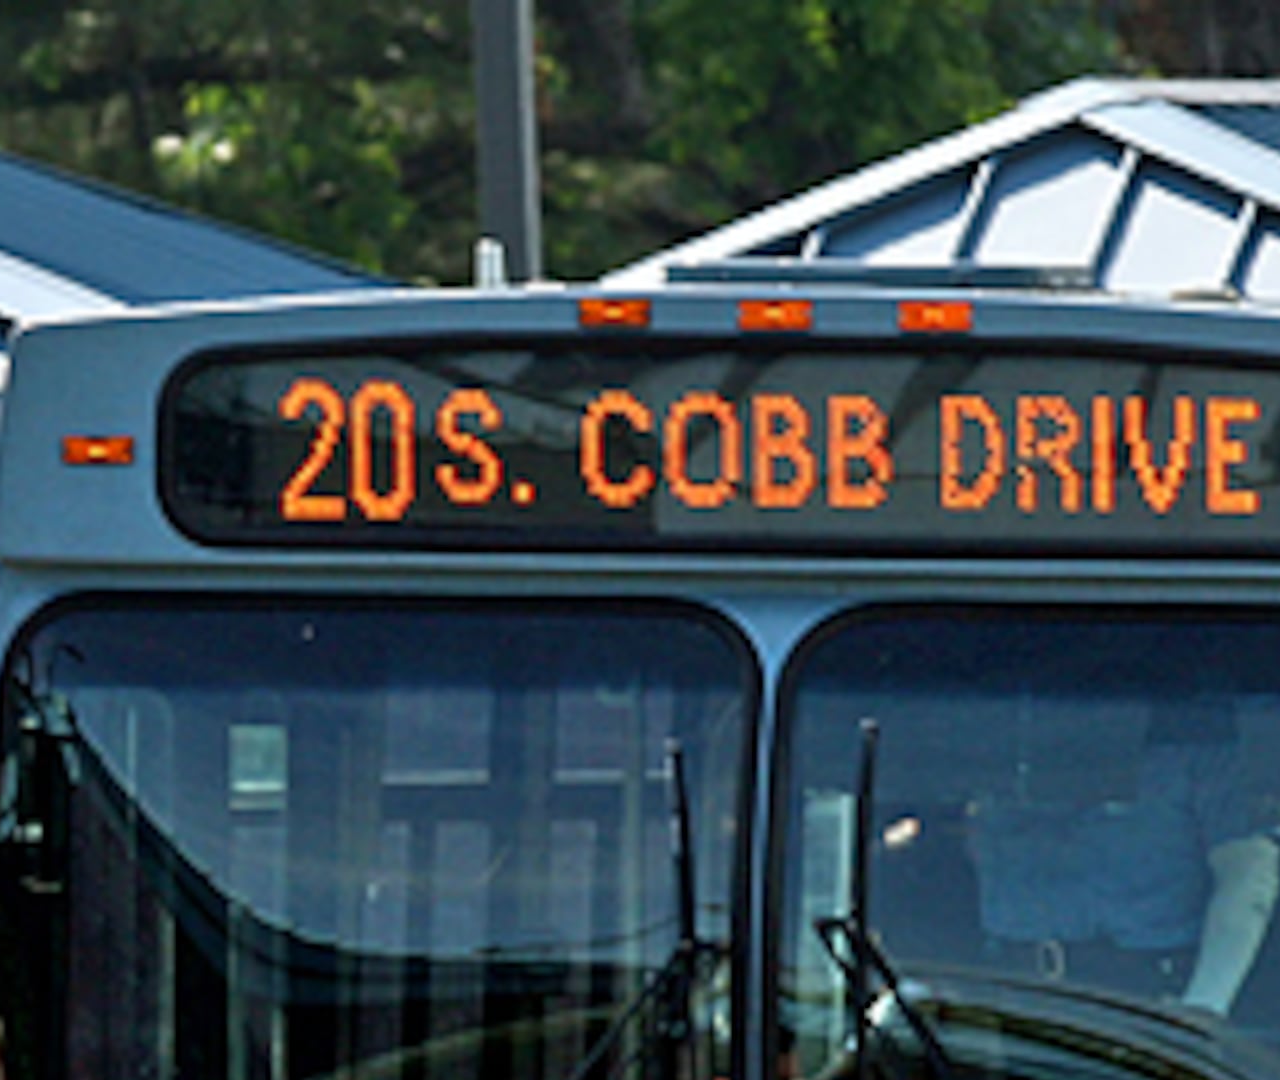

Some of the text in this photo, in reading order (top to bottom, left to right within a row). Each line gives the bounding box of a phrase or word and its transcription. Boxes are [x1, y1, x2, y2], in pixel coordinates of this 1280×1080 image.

[279, 379, 1262, 520] 20 S. COBB DRIVE
